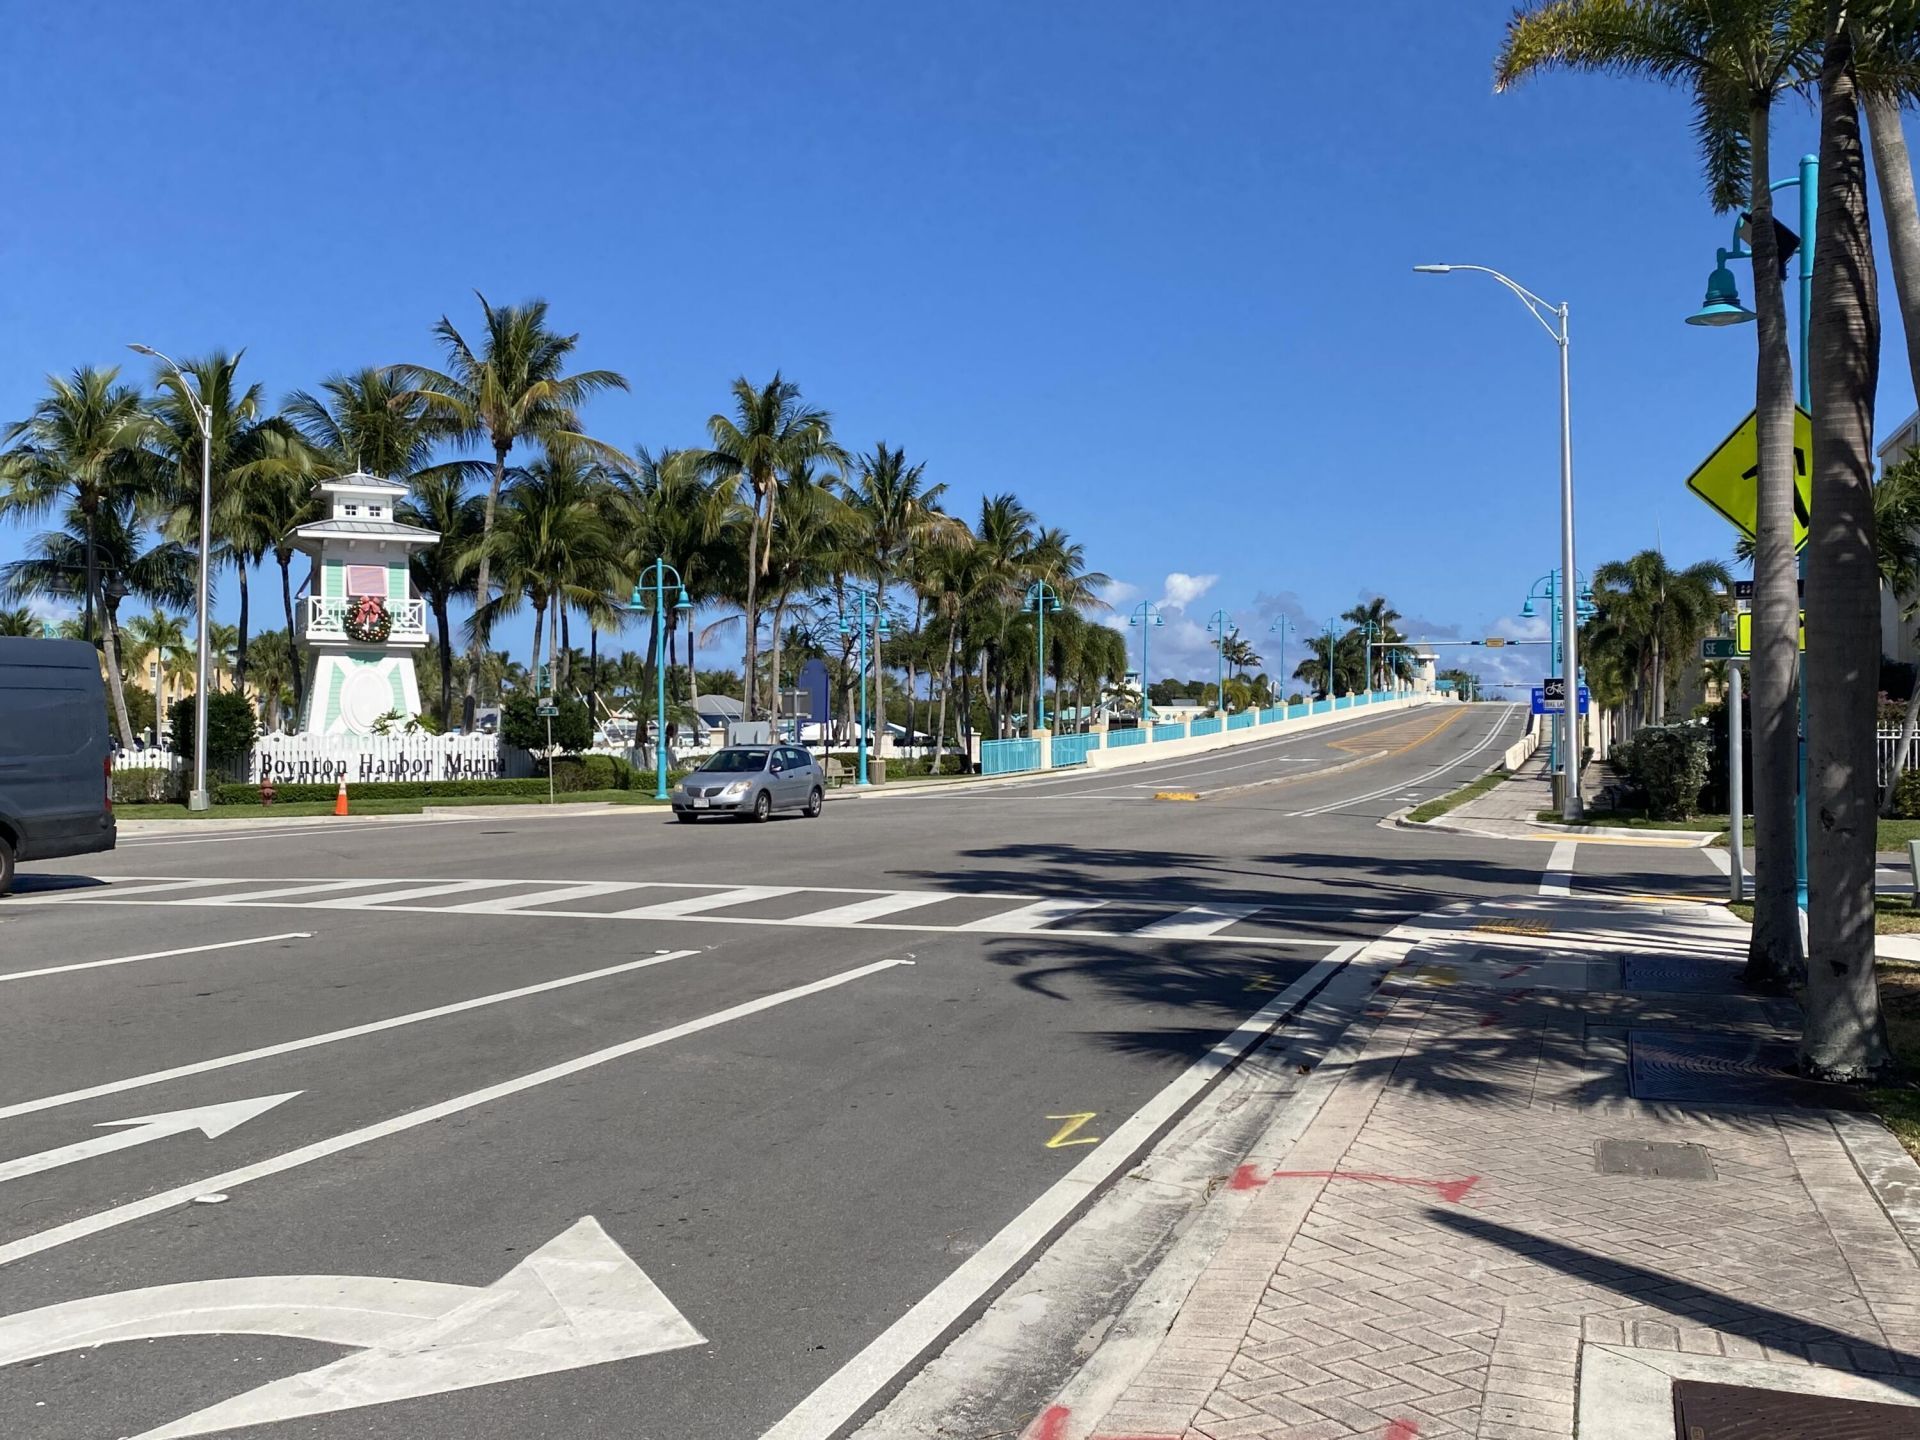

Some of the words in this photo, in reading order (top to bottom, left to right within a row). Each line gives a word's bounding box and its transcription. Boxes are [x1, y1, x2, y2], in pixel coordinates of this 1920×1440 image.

[1705, 642, 1717, 655] SE
[261, 752, 347, 776] Boynton
[360, 751, 433, 774] Harbor
[445, 753, 506, 773] Marina
